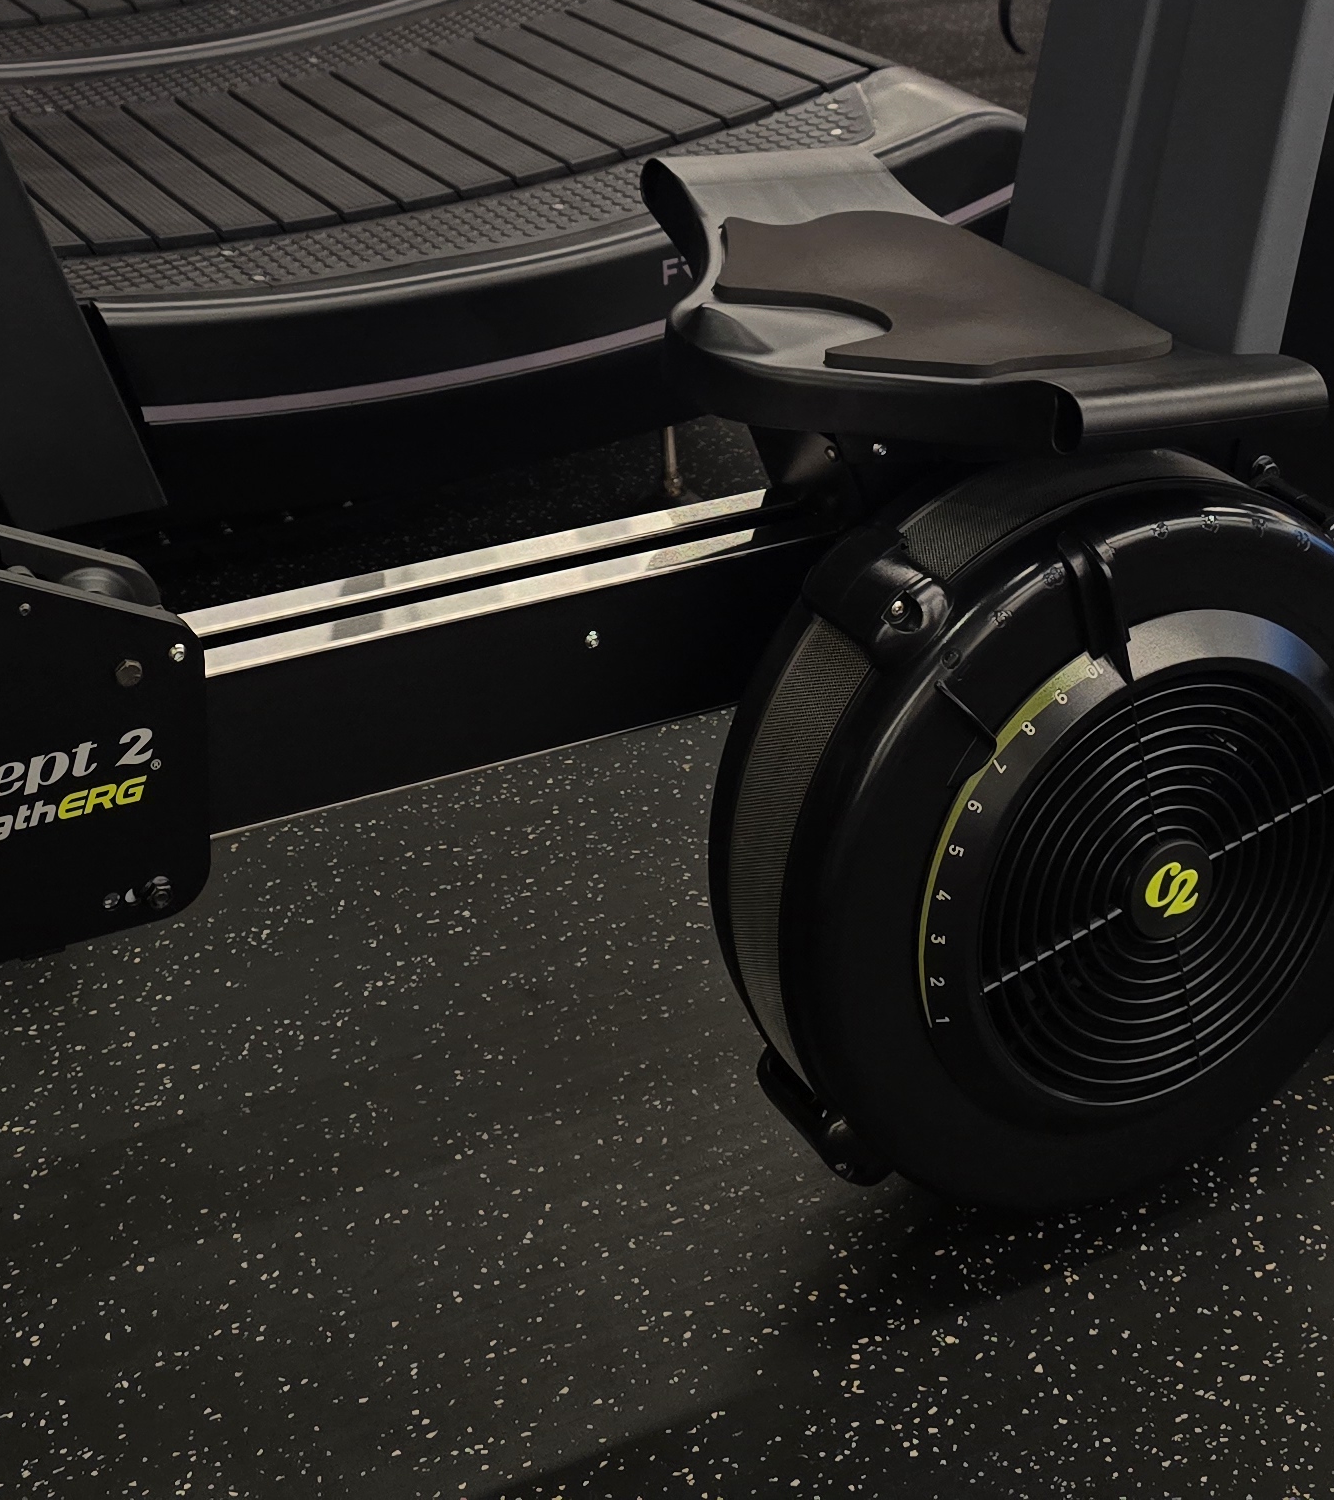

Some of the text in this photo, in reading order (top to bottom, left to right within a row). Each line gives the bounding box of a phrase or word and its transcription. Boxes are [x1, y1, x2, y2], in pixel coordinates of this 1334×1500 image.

[1053, 688, 1068, 706] 9
[1021, 719, 1036, 737] 8
[992, 757, 1008, 776] 7
[967, 799, 984, 815] 6
[948, 841, 965, 858] 5
[935, 888, 952, 904] 4
[1145, 860, 1200, 918] C2
[931, 933, 946, 946] 3
[929, 975, 945, 987] 2
[934, 1015, 950, 1025] 1
